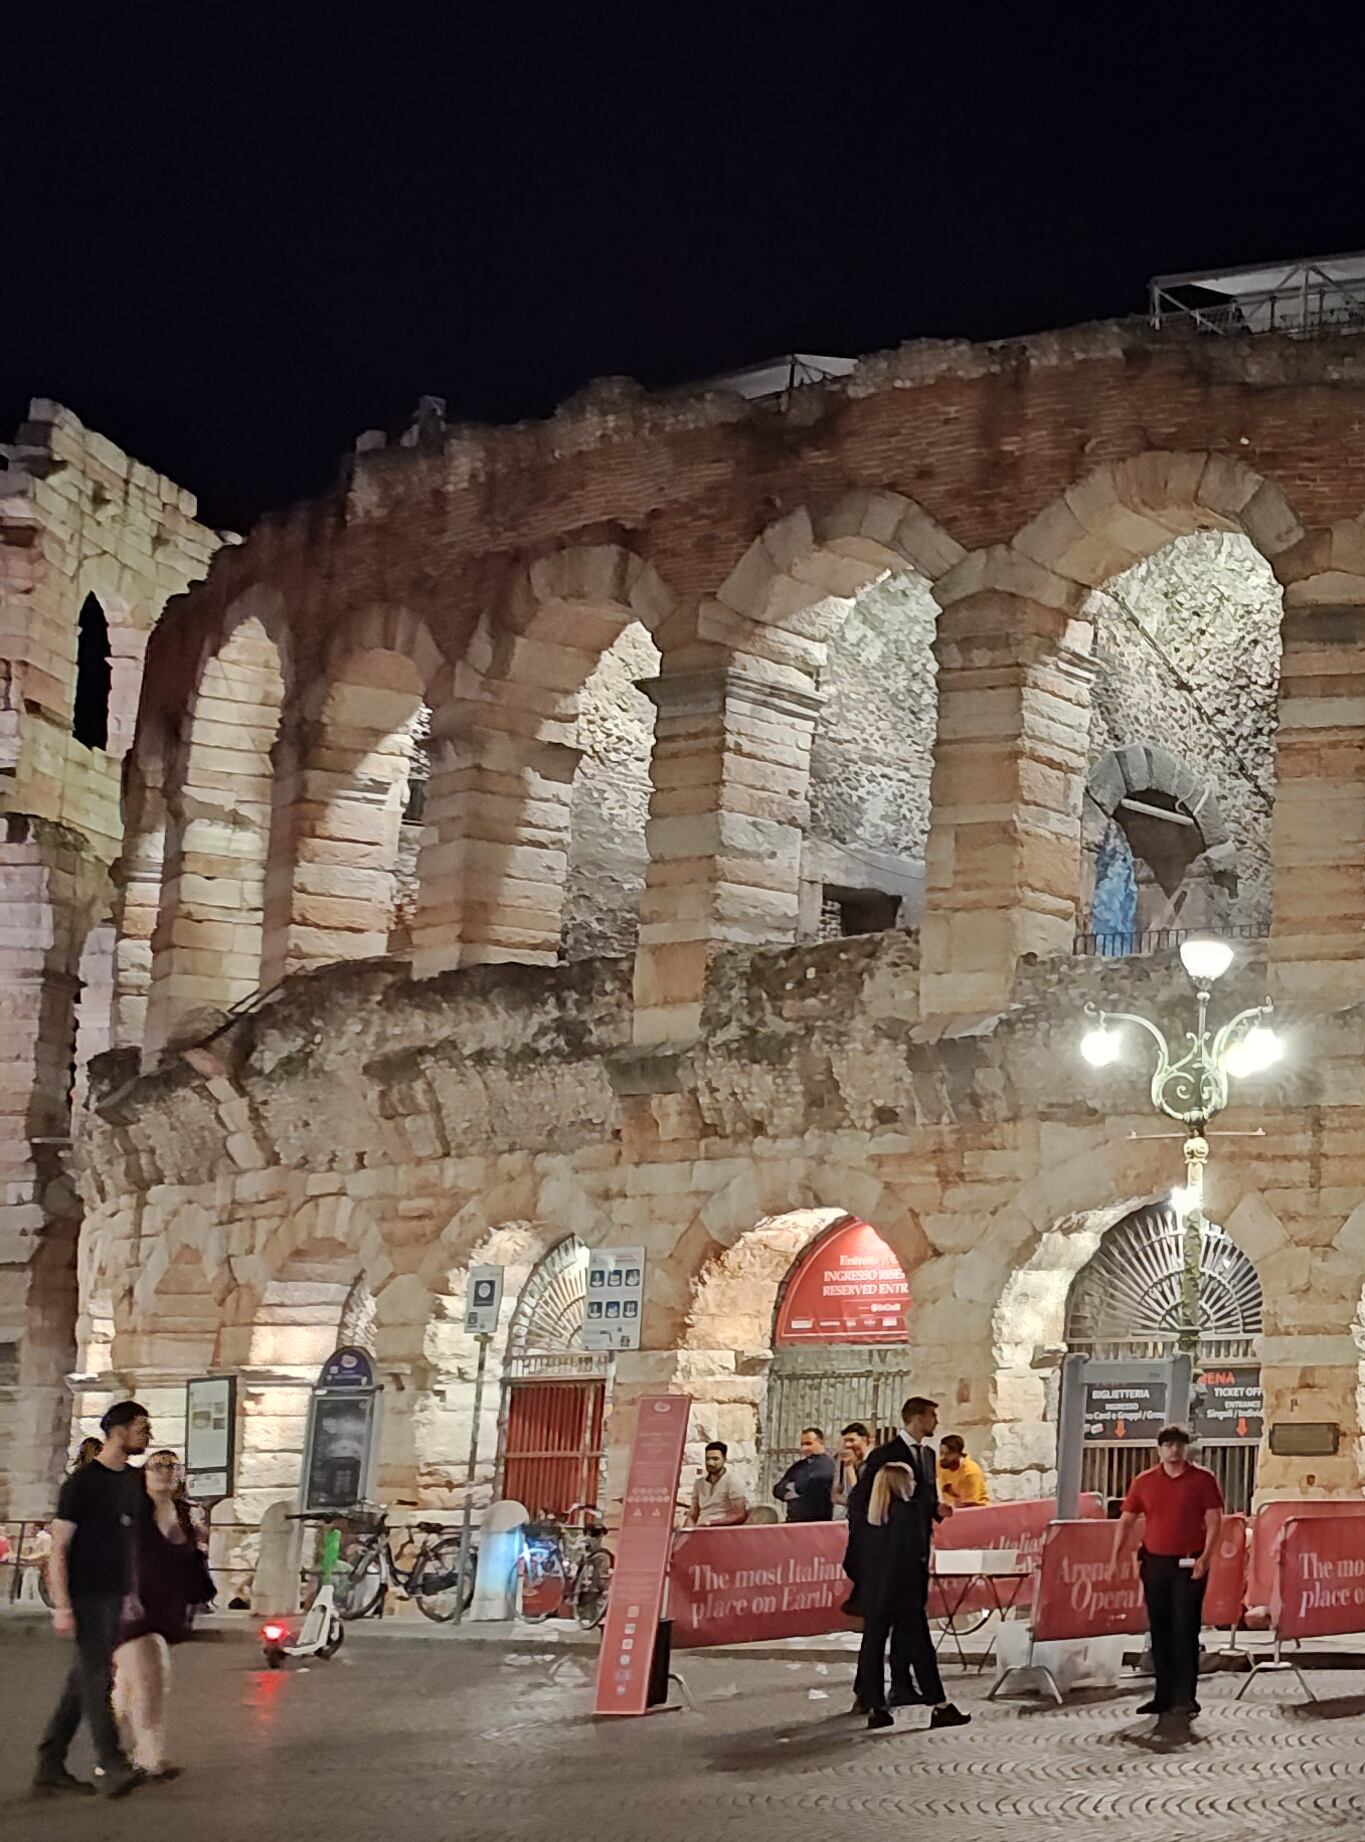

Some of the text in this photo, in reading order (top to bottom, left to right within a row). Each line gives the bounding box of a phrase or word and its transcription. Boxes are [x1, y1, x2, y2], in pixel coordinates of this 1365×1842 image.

[823, 1270, 877, 1282] INGRESSO
[822, 1284, 878, 1297] RESERVED
[1091, 1389, 1151, 1400] BIGLIETTERIA
[1213, 1386, 1245, 1397] TICKET
[688, 1563, 729, 1592] The
[735, 1567, 785, 1588] most
[1298, 1552, 1334, 1580] The
[691, 1598, 748, 1629] place
[752, 1594, 777, 1615] on
[1070, 1577, 1134, 1620] Opera
[1298, 1581, 1350, 1618] place
